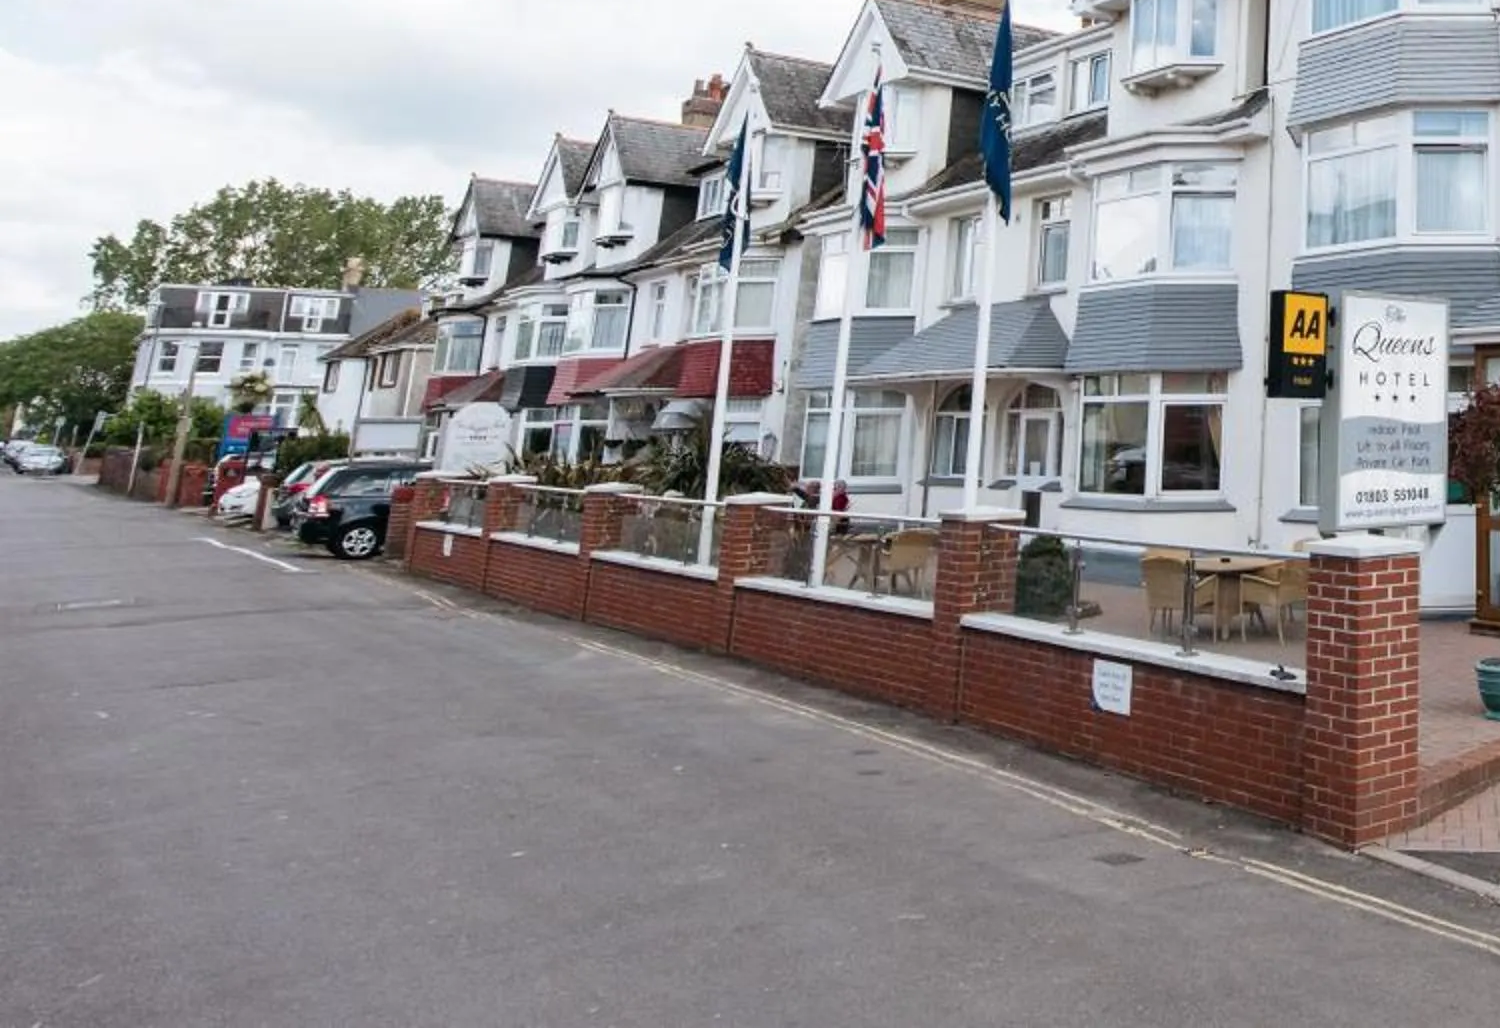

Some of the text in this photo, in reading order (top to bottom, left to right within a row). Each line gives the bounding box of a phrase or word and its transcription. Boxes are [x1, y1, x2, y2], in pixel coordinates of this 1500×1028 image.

[1290, 310, 1320, 339] AA
[1353, 321, 1437, 363] Queens
[1359, 372, 1431, 387] HOTEL
[1355, 490, 1389, 503] 01803
